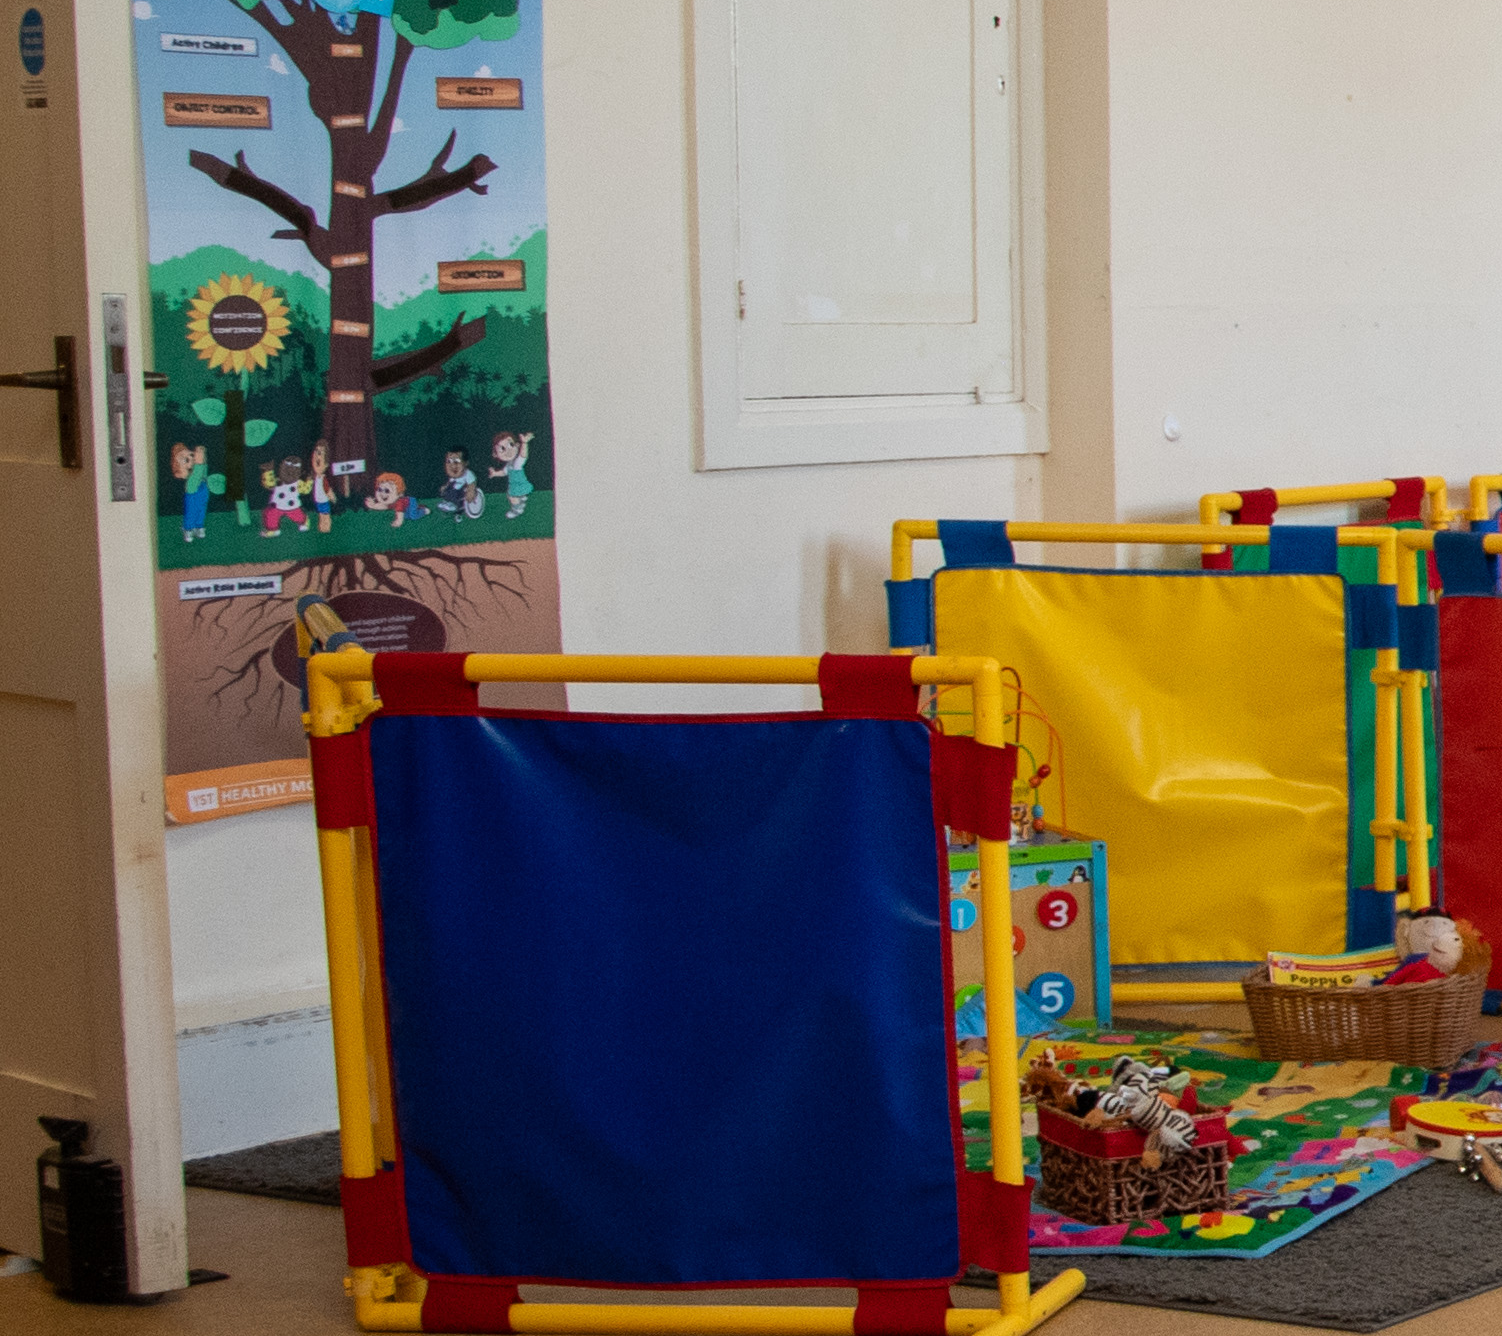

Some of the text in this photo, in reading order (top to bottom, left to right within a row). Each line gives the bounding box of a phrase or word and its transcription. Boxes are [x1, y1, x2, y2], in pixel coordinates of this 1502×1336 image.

[221, 782, 287, 803] HEALTHY
[1049, 899, 1070, 928] 3
[1289, 973, 1338, 987] Poppy
[1040, 981, 1064, 1014] 5
